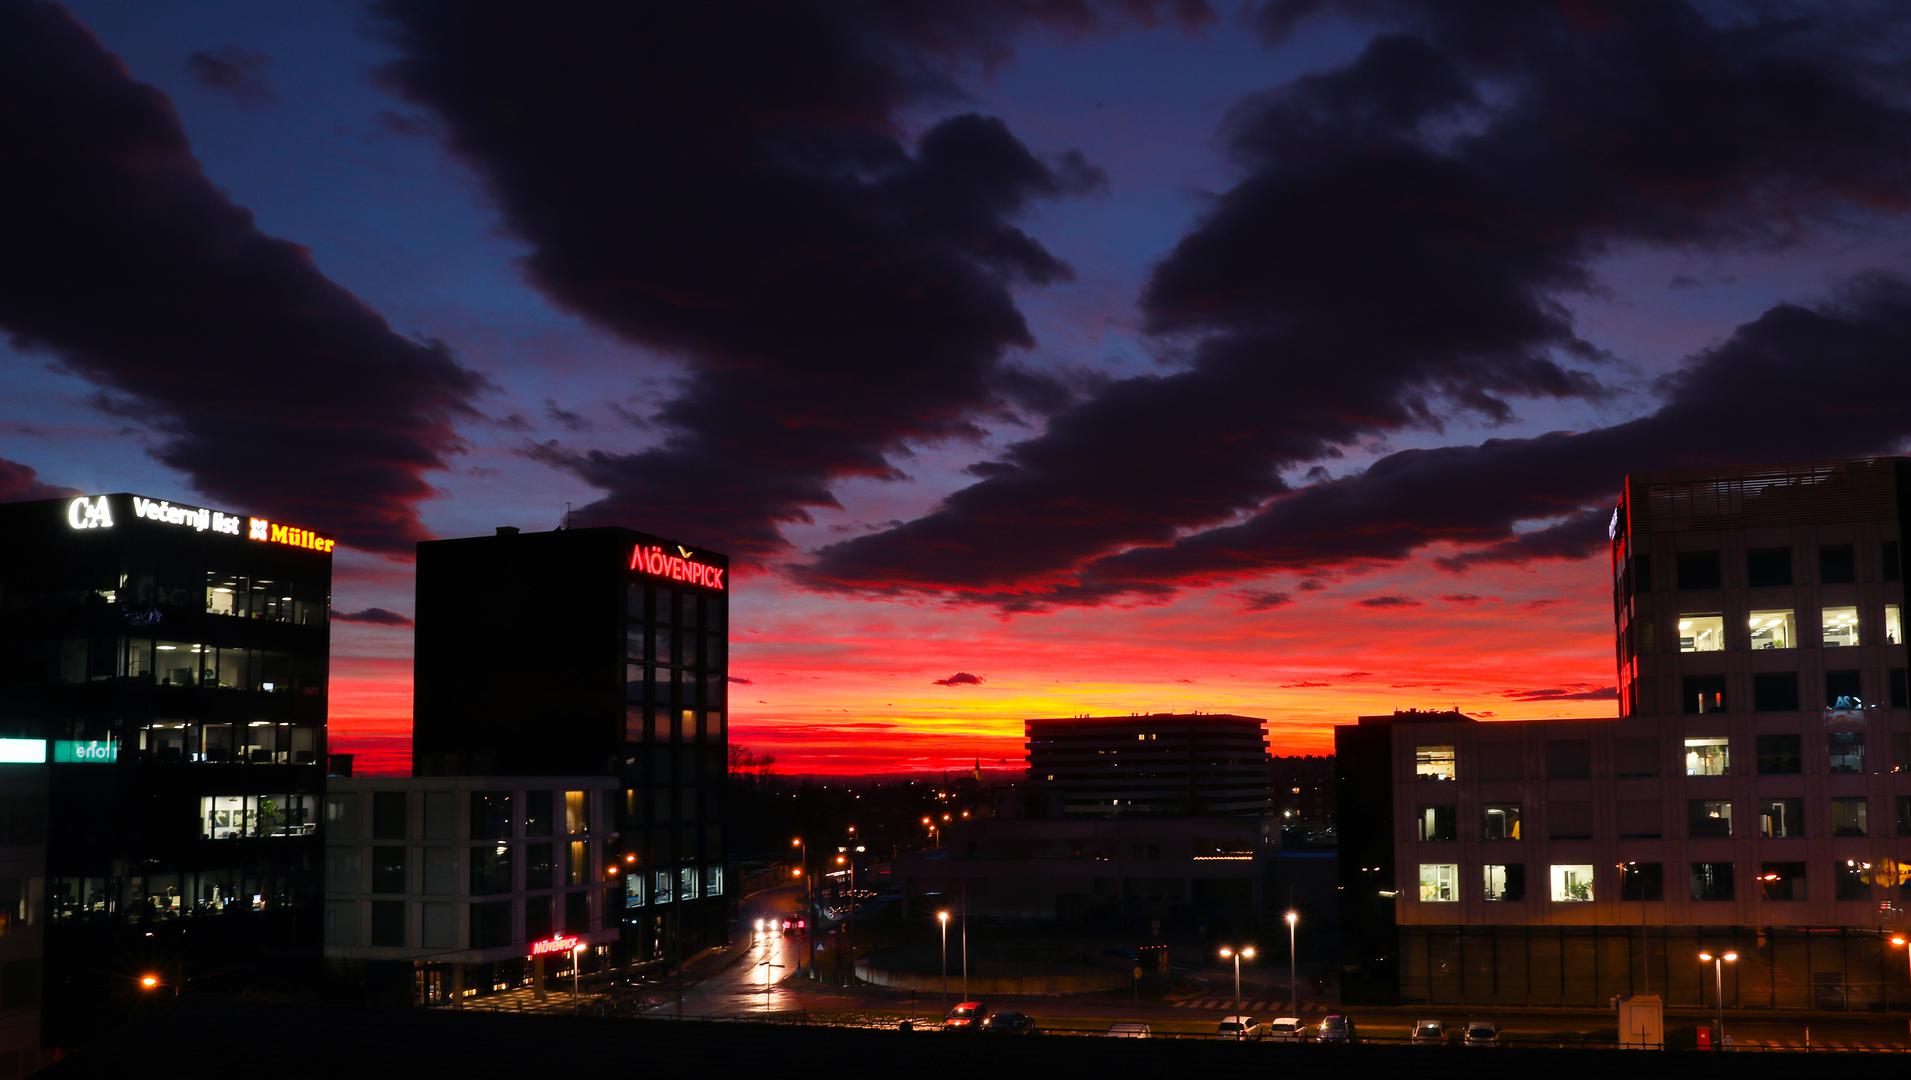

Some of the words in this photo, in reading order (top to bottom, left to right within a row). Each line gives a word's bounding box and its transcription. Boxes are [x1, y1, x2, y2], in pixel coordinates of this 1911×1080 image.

[68, 496, 113, 529] C&A
[132, 496, 210, 532] Večernji
[211, 511, 241, 535] list
[270, 523, 335, 553] Müller
[630, 544, 724, 589] MÖVENPICK
